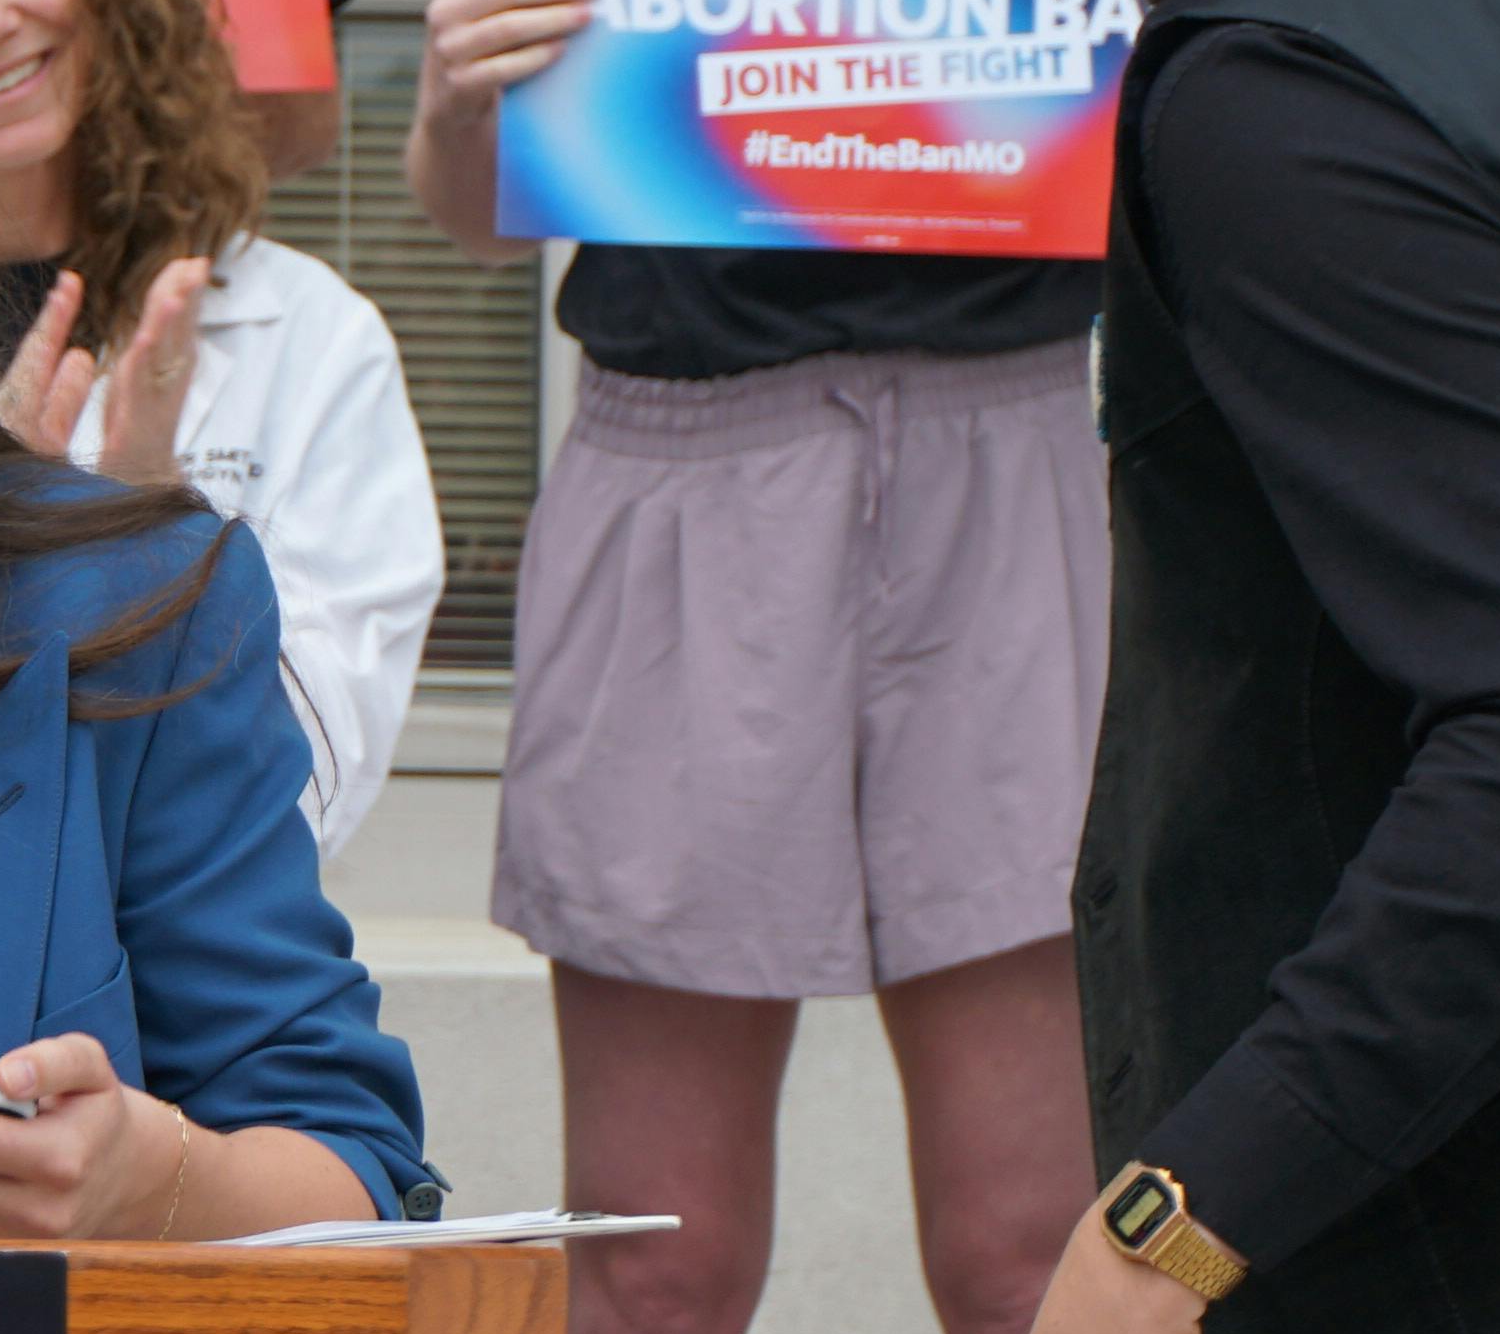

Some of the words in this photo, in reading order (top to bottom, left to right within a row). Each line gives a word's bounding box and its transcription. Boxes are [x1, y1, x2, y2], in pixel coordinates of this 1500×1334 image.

[720, 58, 819, 106] JOIN
[836, 52, 921, 92] THE
[940, 43, 1070, 85] FIGHT
[744, 129, 1025, 177] #EndTheBanMO
